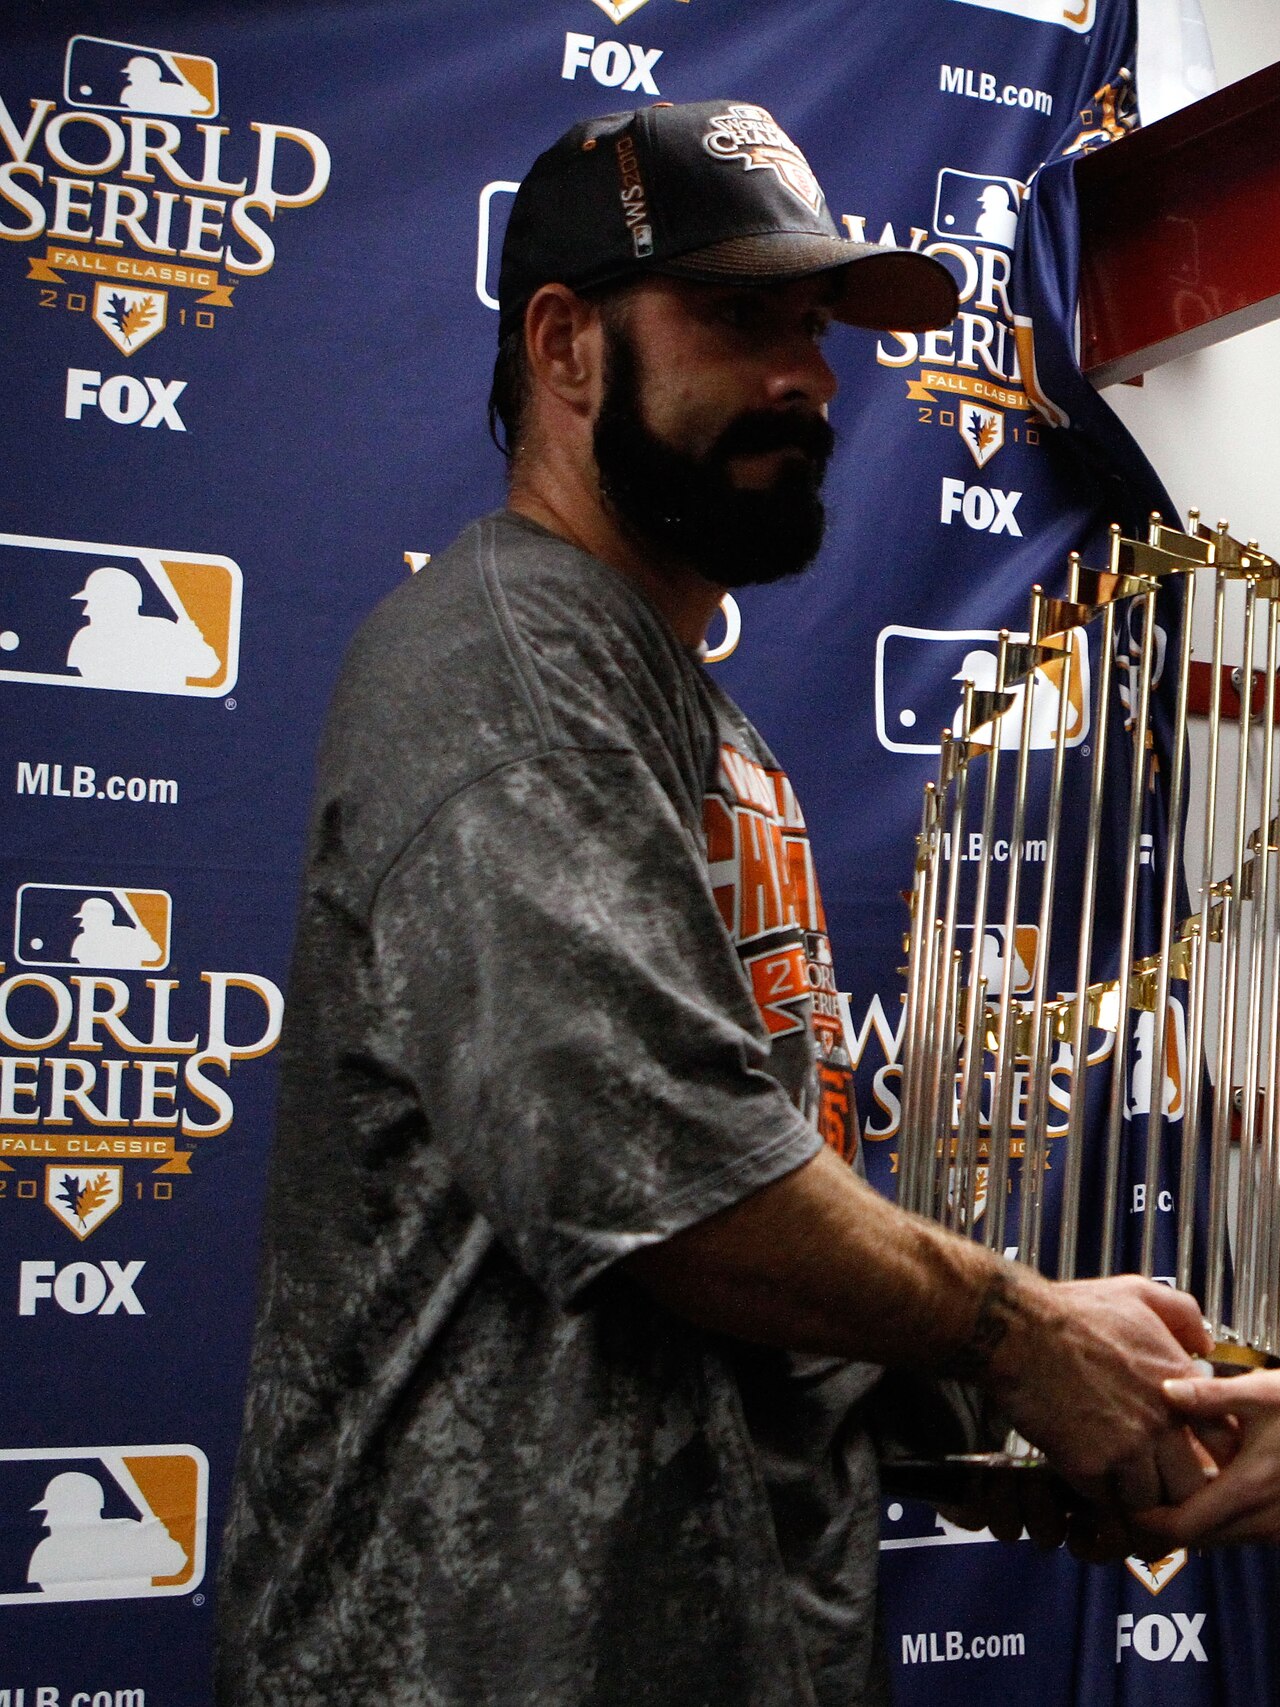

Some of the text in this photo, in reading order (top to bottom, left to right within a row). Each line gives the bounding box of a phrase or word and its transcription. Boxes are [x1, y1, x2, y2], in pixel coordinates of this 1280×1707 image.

[562, 32, 664, 96] FOX
[939, 64, 1054, 116] MLB.com
[0, 161, 277, 277] SERIES
[54, 251, 212, 287] FALL CLASSIC
[65, 367, 189, 432] FOX
[926, 374, 968, 391] FALL
[941, 477, 1023, 537] FOX
[16, 762, 179, 804] MLB.com
[0, 964, 285, 1060] ORLD
[2, 1138, 168, 1154] FALL CLASSIC
[19, 1259, 147, 1316] FOX
[901, 1630, 1026, 1665] MLB.com
[1116, 1612, 1209, 1664] FOX
